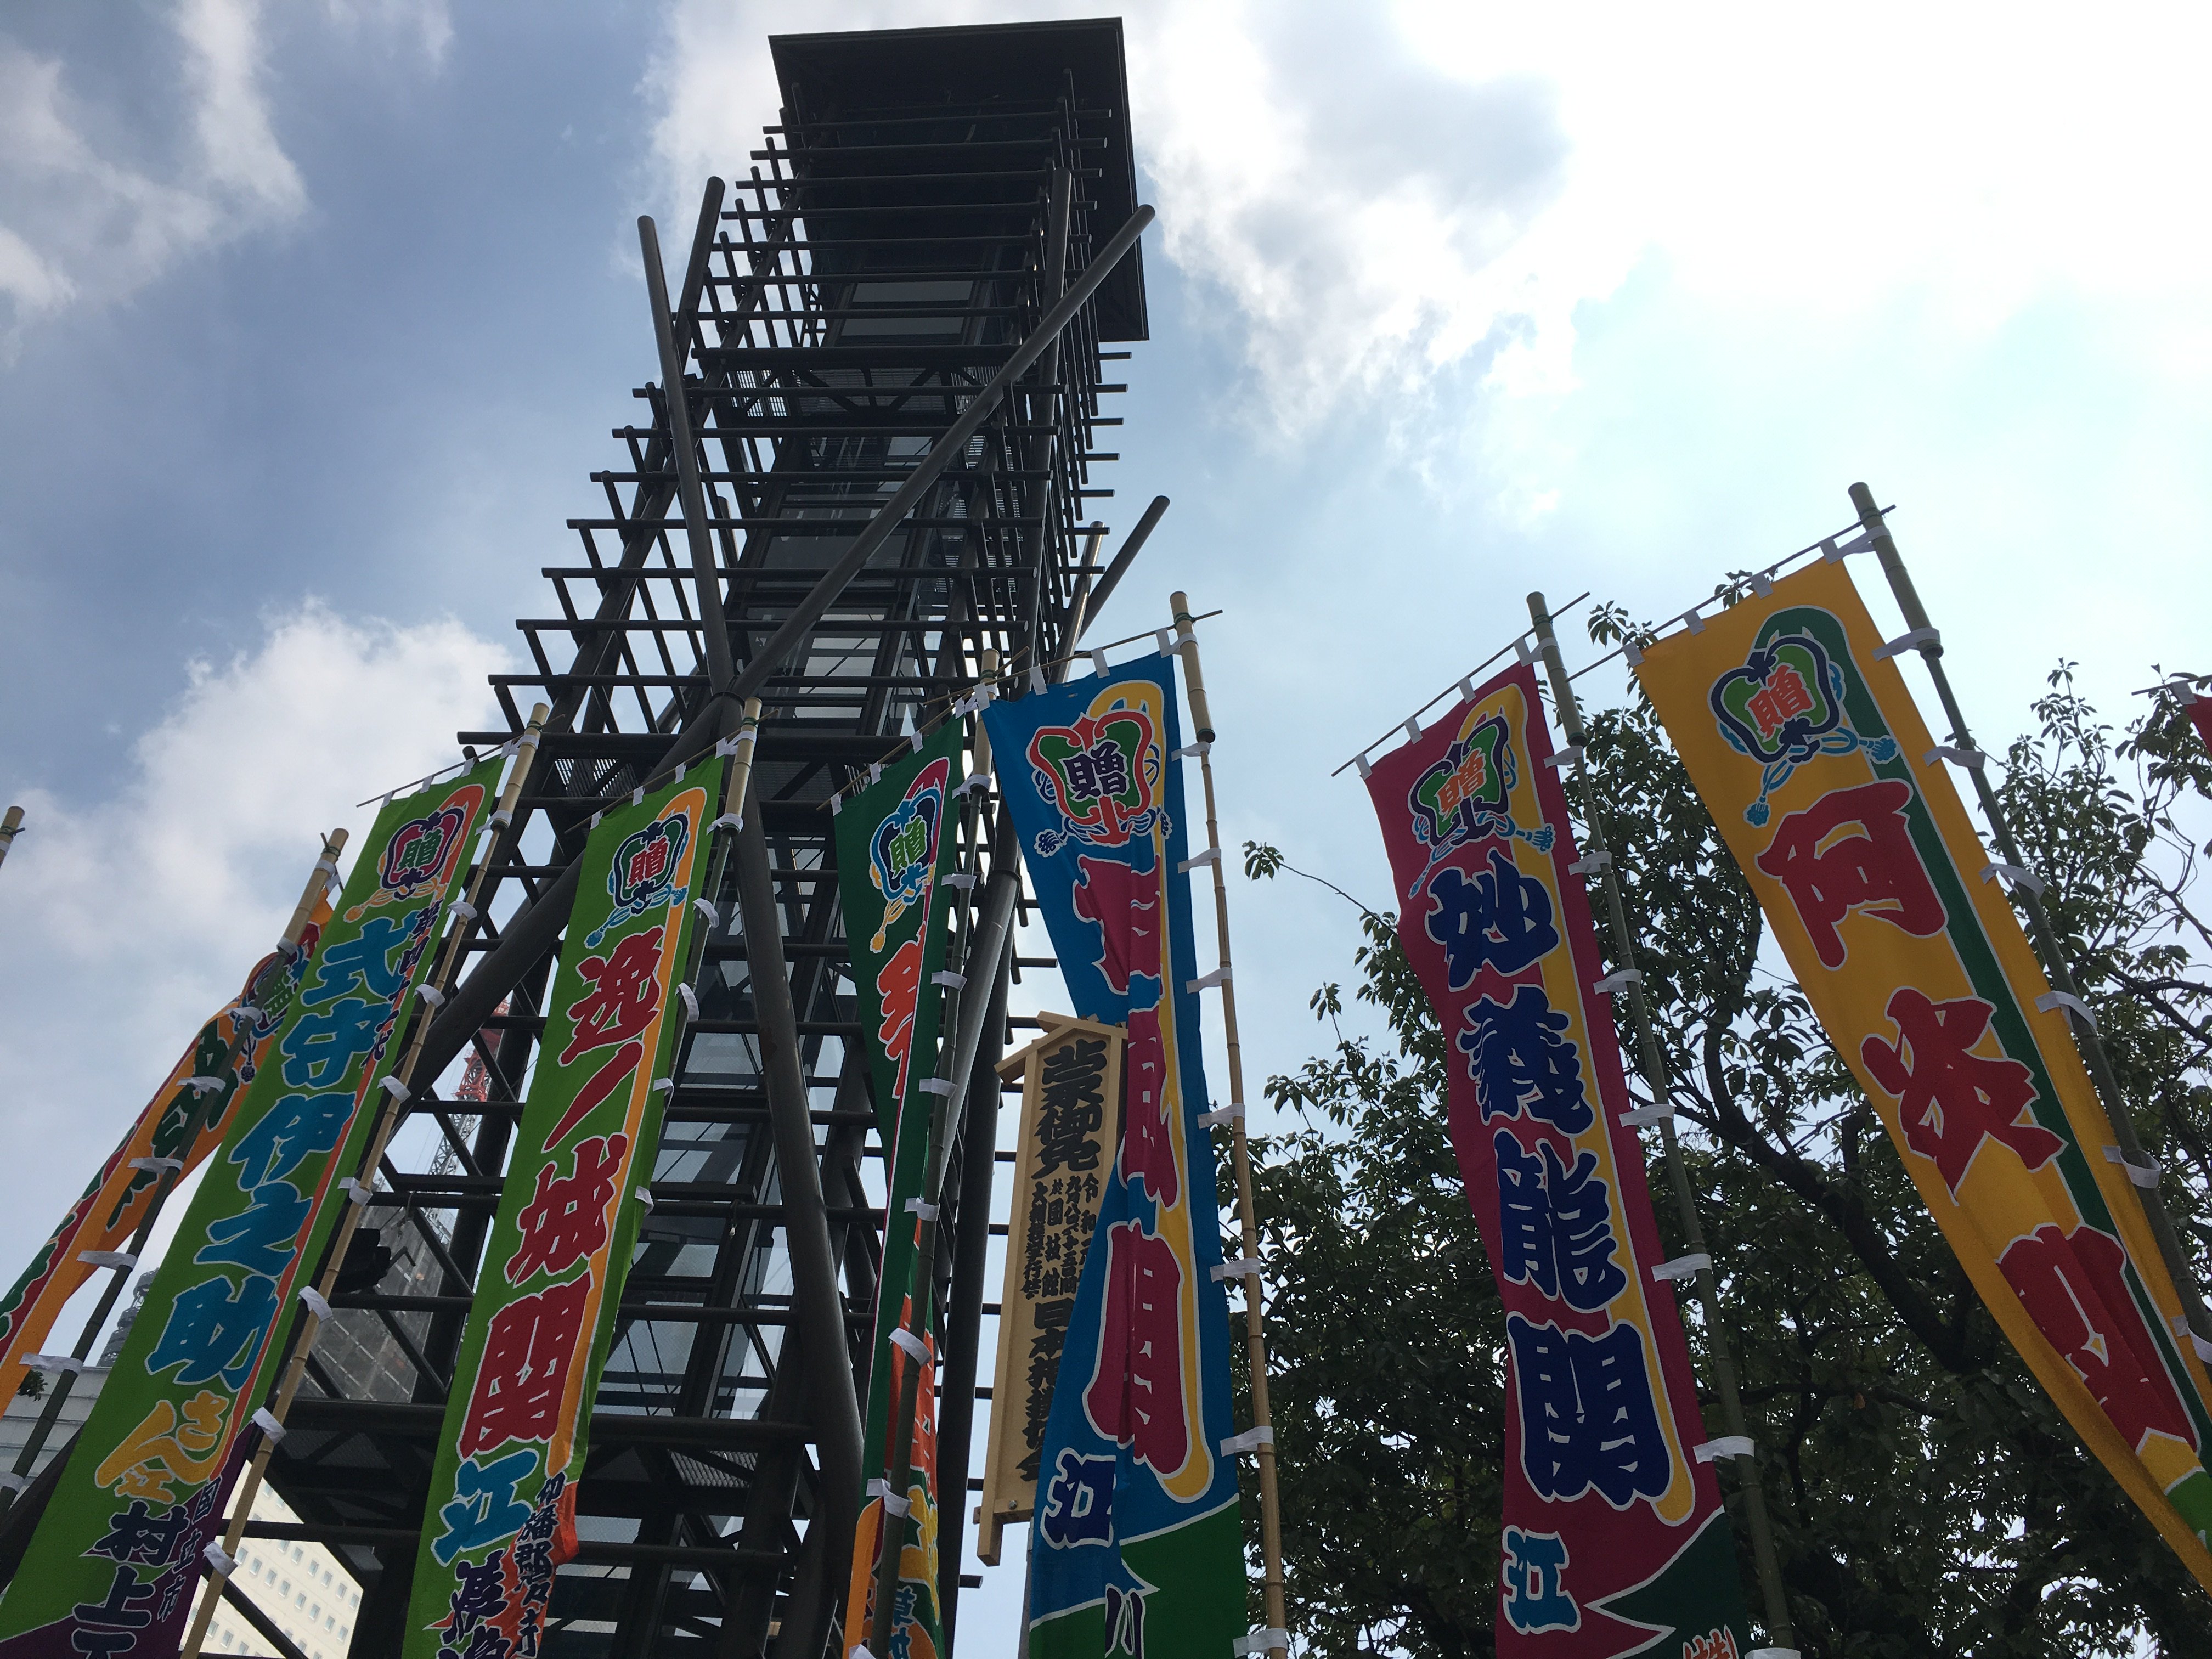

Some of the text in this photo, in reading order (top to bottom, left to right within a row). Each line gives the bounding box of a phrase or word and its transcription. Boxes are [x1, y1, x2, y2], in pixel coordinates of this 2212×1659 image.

[1743, 663, 1814, 741] 贈
[1062, 739, 1128, 800] 贈
[1438, 749, 1487, 816] 贈
[397, 830, 441, 872] 贈
[627, 837, 667, 887] 贈
[889, 815, 927, 878] 贈
